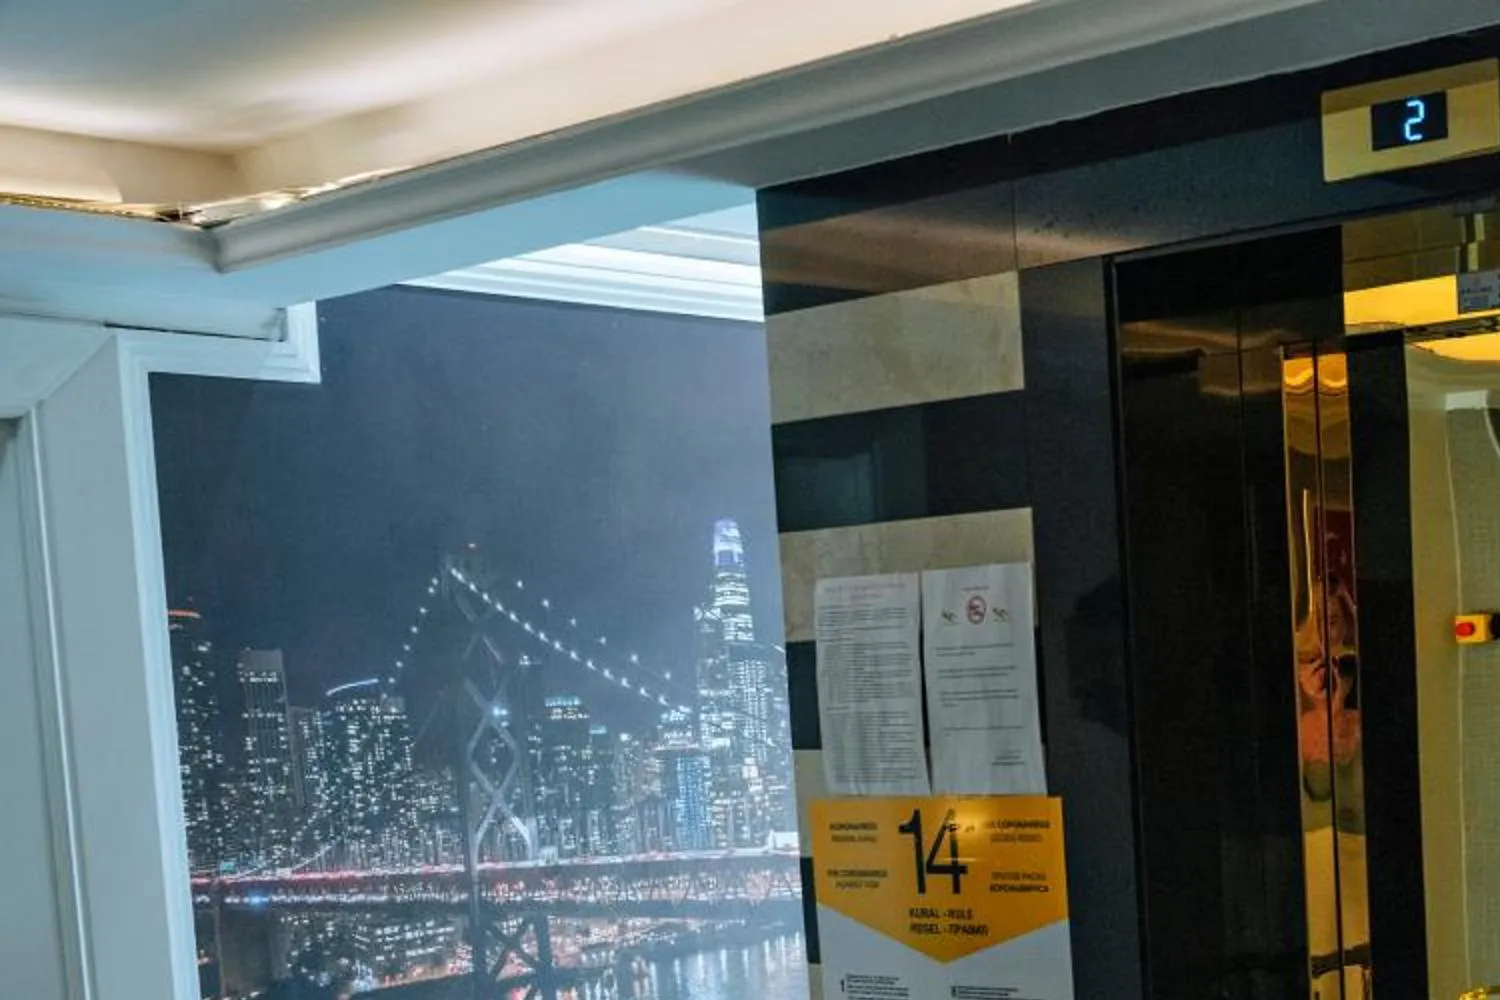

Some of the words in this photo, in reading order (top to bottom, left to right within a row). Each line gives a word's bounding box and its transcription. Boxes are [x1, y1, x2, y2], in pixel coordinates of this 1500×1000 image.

[1403, 100, 1425, 142] 2
[898, 807, 969, 895] 14
[909, 907, 941, 919] KURAL
